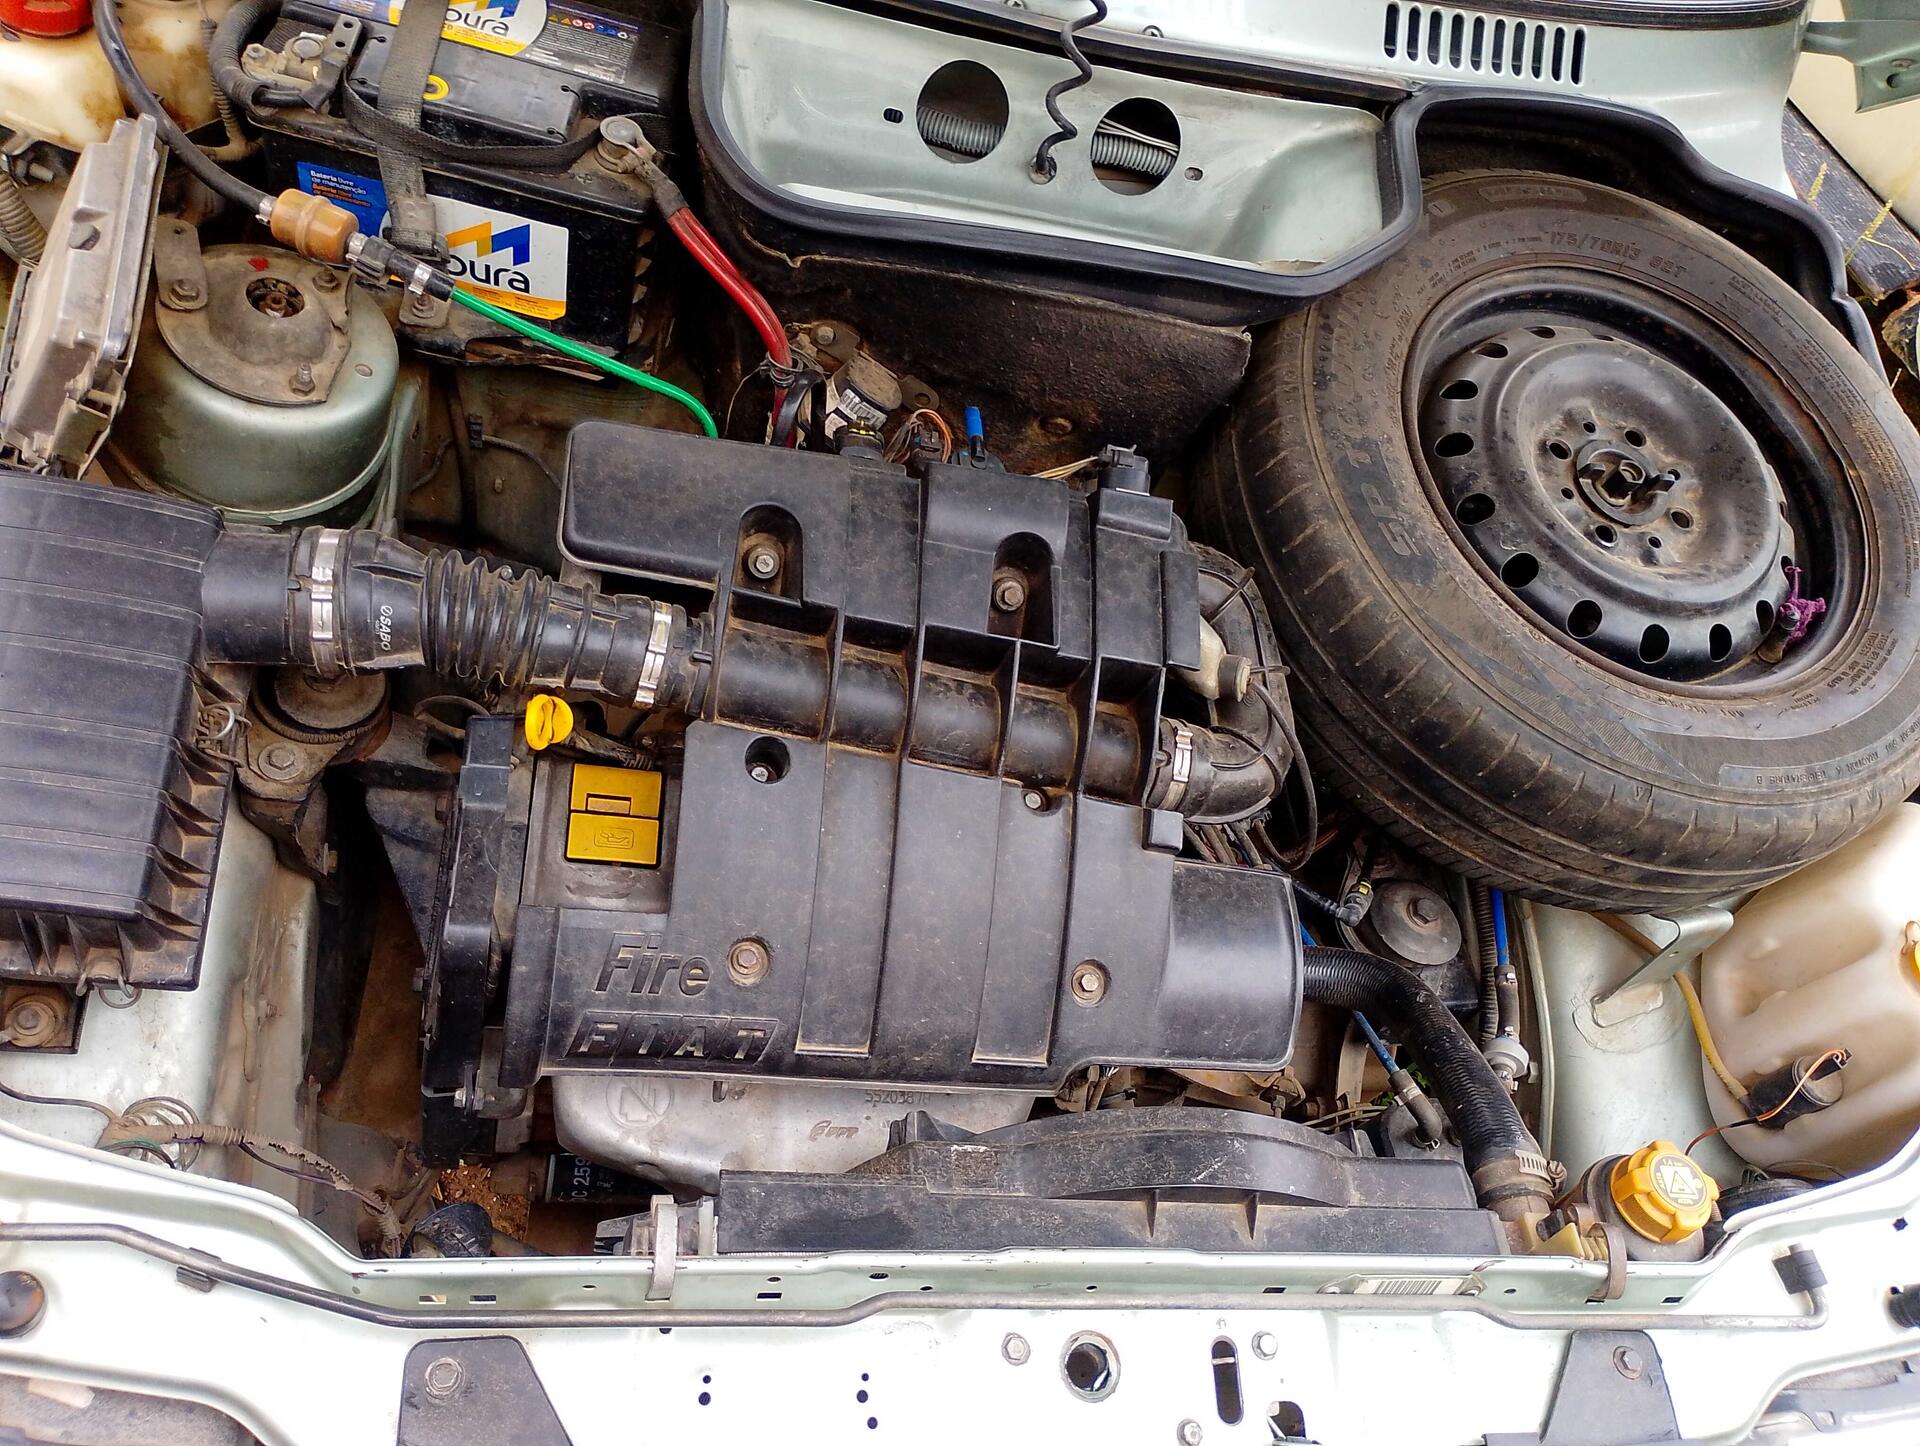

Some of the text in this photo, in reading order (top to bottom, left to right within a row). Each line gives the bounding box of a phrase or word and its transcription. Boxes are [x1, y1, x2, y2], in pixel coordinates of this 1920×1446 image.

[445, 8, 509, 37] oura
[449, 254, 530, 294] oura
[1847, 752, 1880, 773] TRACTION
[592, 931, 712, 997] Fire
[577, 1022, 766, 1060] FIAT
